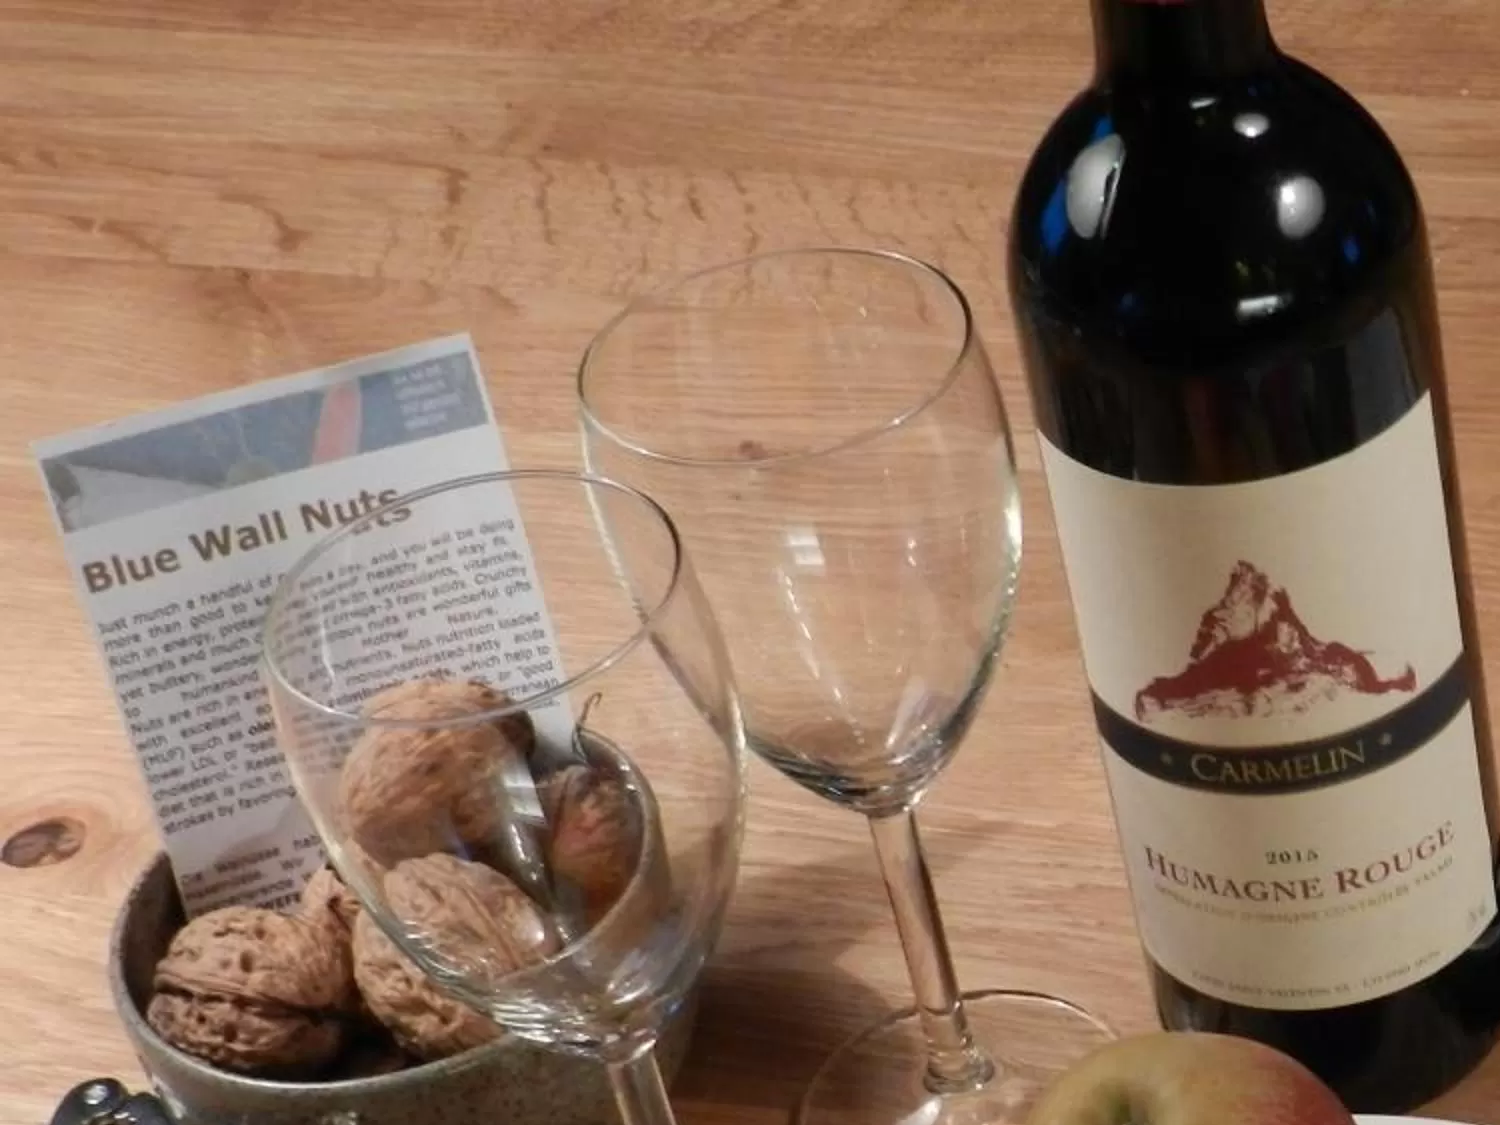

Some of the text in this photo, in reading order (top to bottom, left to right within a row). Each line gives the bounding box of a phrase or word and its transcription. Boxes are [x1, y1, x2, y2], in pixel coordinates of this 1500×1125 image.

[82, 489, 402, 593] Blue Wall Nuts
